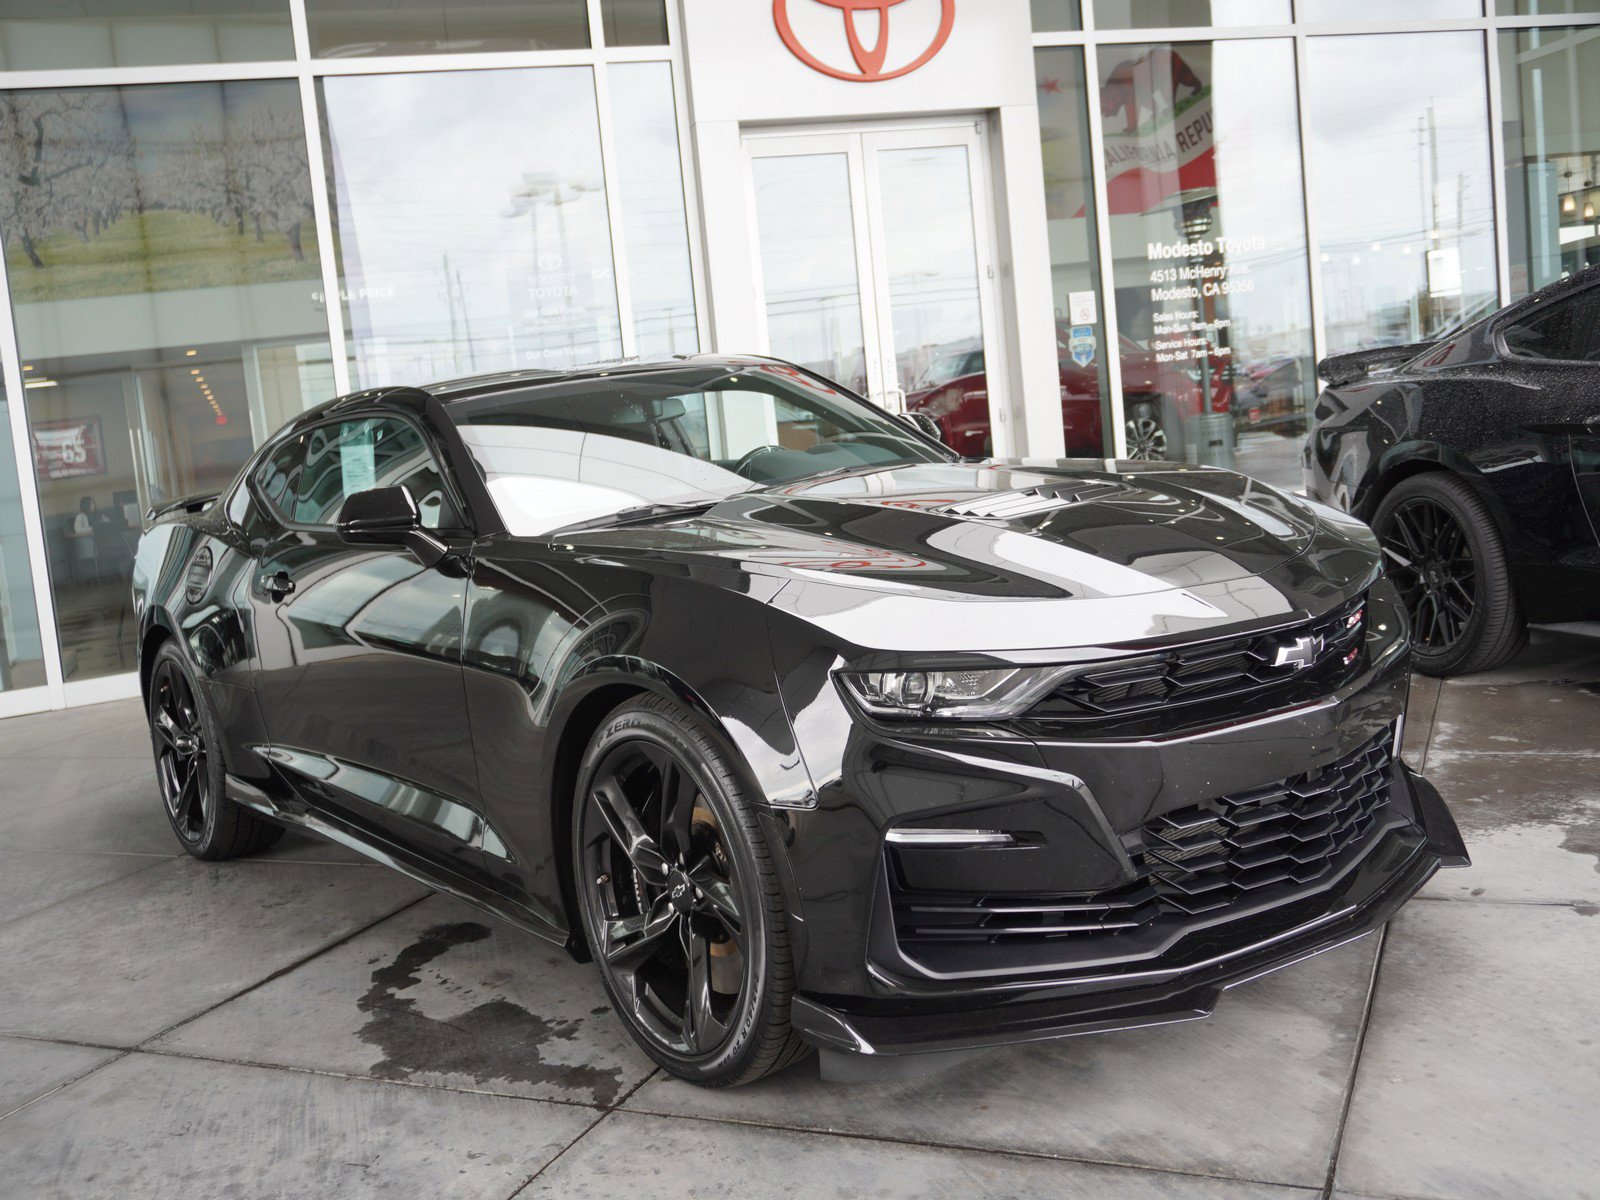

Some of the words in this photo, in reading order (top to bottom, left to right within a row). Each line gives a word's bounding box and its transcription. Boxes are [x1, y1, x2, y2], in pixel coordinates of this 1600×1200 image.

[1103, 141, 1176, 171] ALIFORNIA
[1147, 241, 1213, 260] Modesto
[1215, 236, 1266, 255] Toyota
[1150, 268, 1177, 283] 4513
[1179, 264, 1228, 280] McHenry
[528, 285, 578, 300] TOYOTA
[1150, 286, 1201, 302] Modesto,
[1203, 281, 1221, 297] CA
[1175, 310, 1199, 320] Hours:
[1153, 323, 1188, 335] Mon-Sun
[1155, 339, 1183, 351] Service
[1155, 350, 1188, 363] Mon-Sat
